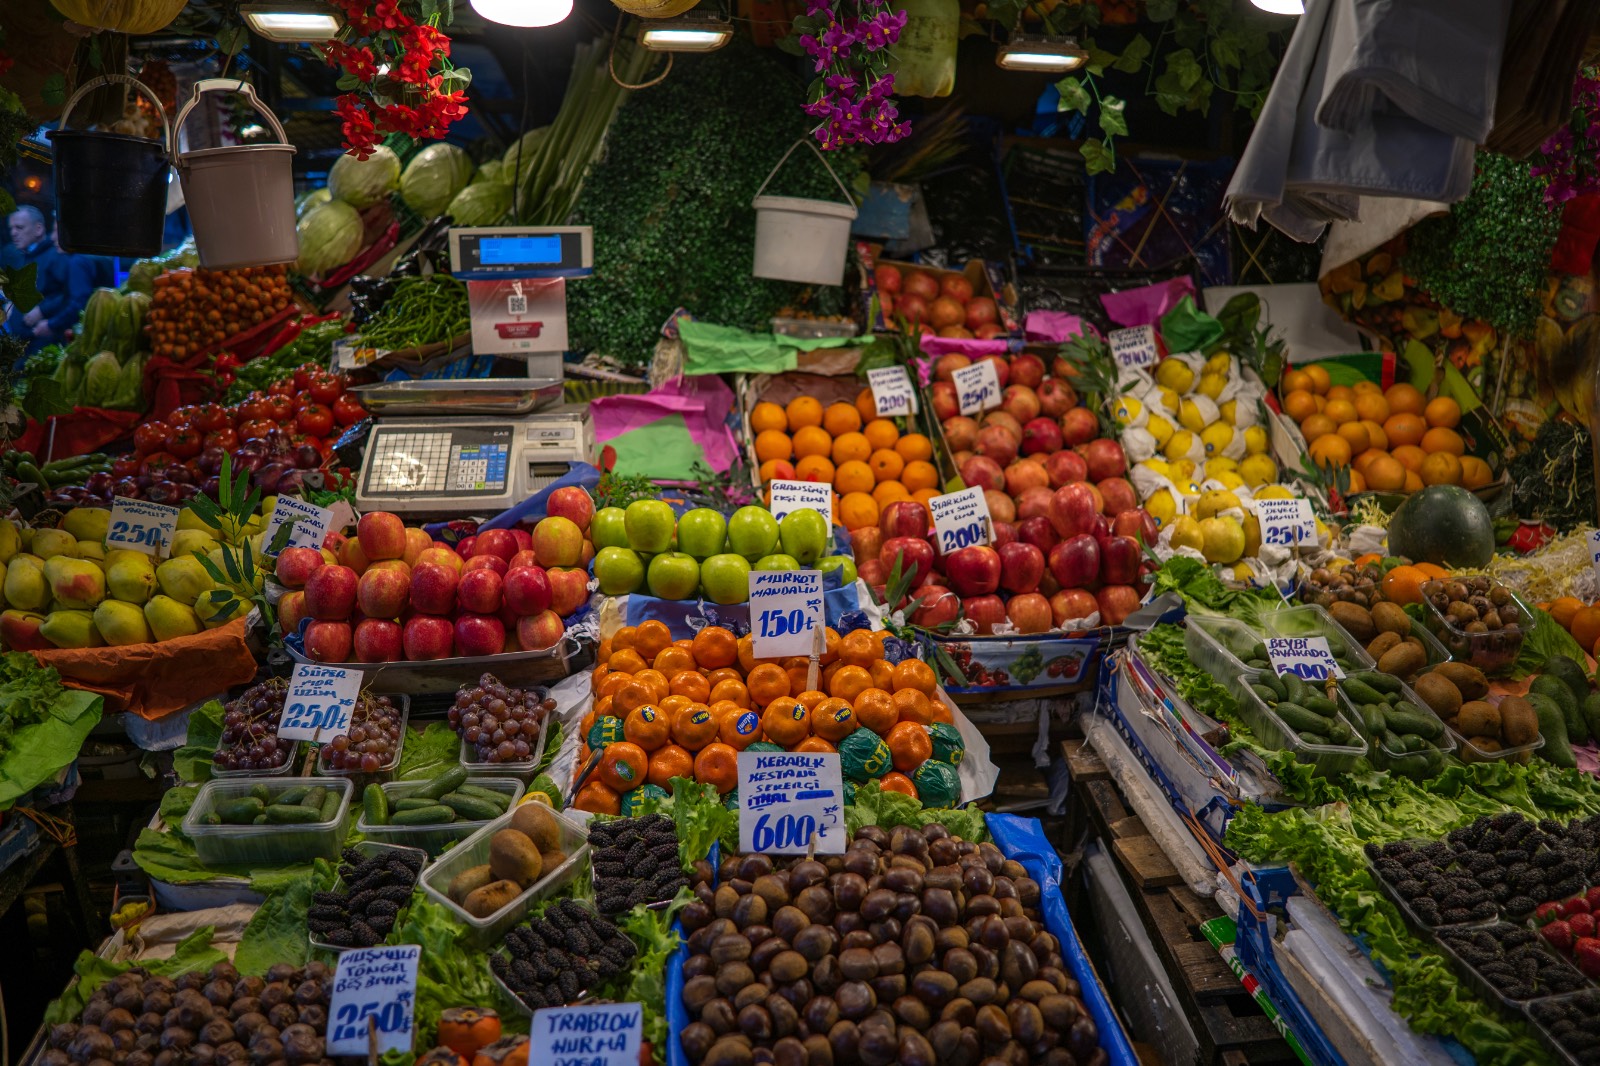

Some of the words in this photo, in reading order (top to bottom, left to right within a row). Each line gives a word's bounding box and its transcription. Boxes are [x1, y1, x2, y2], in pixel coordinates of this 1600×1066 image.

[800, 495, 825, 503] ELMA
[756, 573, 818, 584] MURKOT
[1269, 648, 1329, 658] AVAKADO
[298, 666, 346, 678] SÜPER
[293, 685, 337, 698] ÜZÜM
[748, 768, 817, 783] KESTANE
[547, 1011, 639, 1034] TRABZON
[552, 1033, 627, 1054] HURMA
